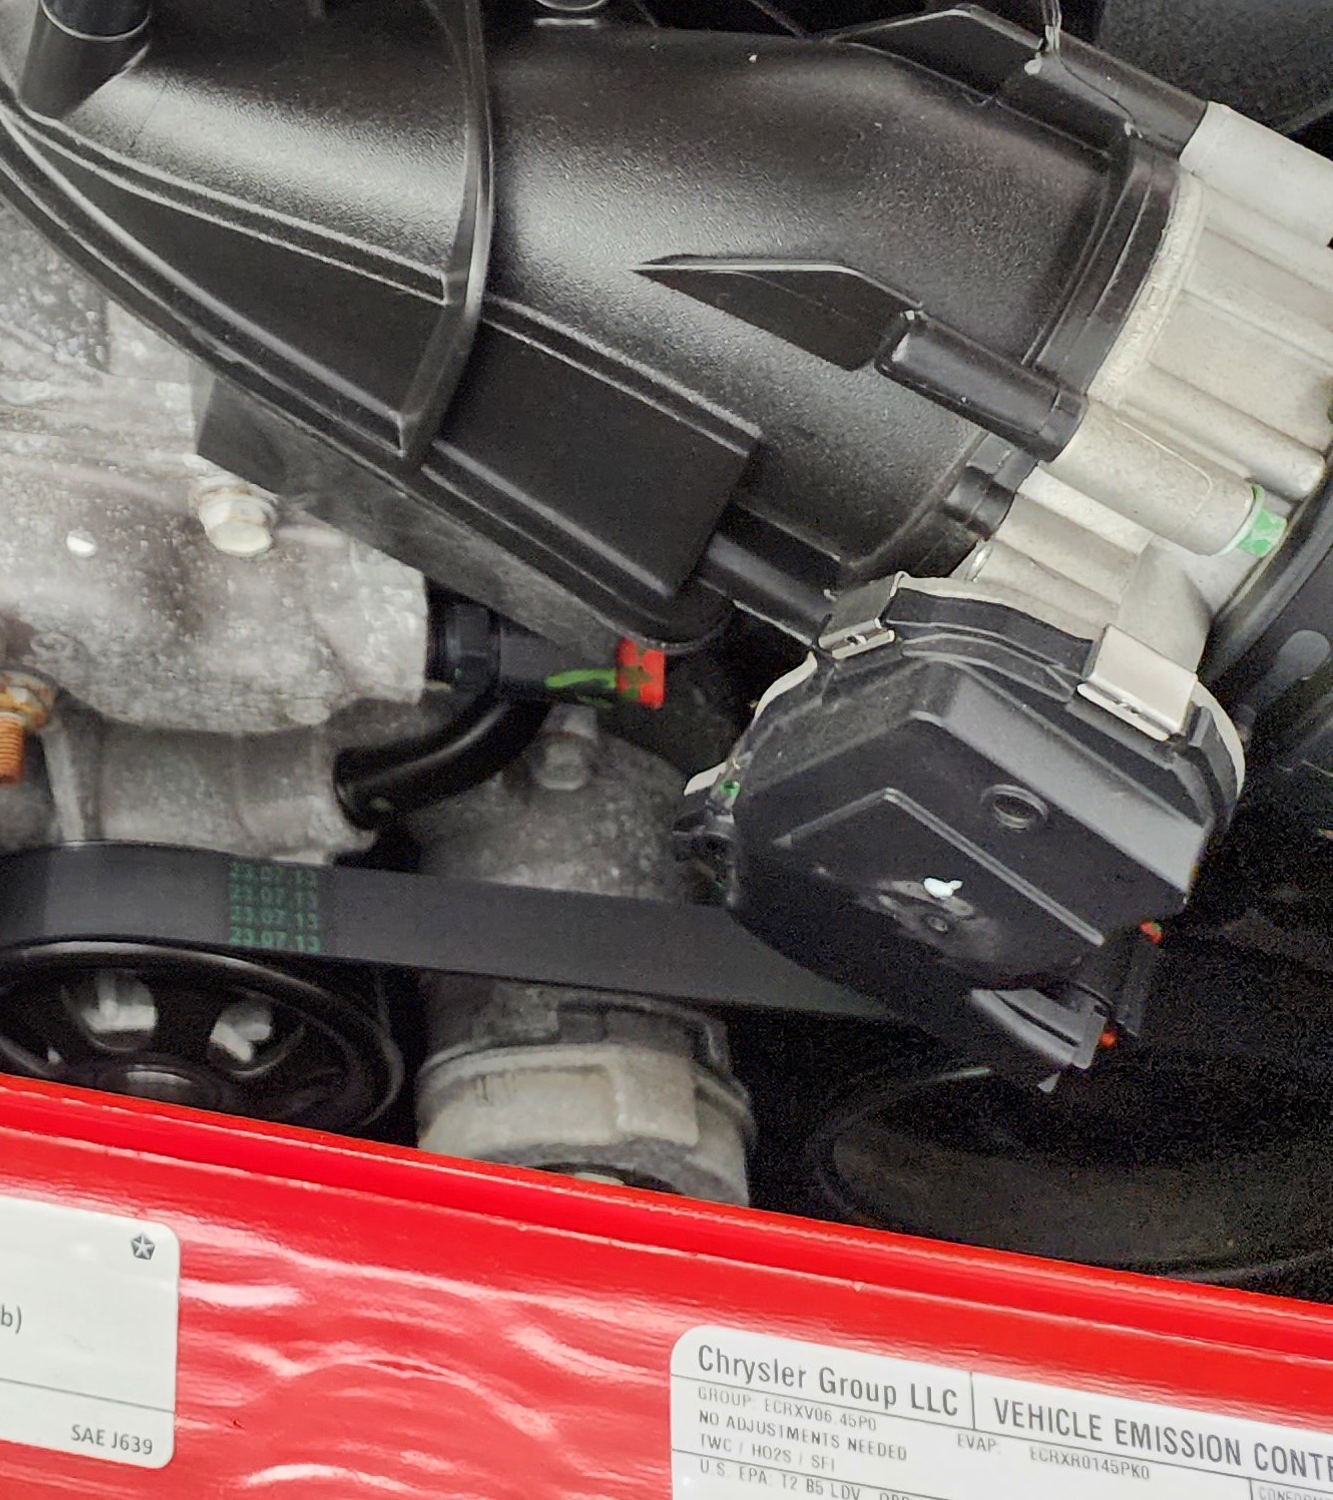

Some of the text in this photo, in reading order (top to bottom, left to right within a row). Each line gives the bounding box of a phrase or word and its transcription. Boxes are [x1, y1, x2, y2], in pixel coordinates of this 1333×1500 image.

[698, 1344, 959, 1417] Chrysler Group LLC
[70, 1424, 153, 1455] SAE J639
[698, 1410, 908, 1462] NO ADJUSTMENTS NEEDED
[700, 1434, 732, 1452] TWC
[811, 1454, 836, 1472] SFI
[993, 1397, 1104, 1442] VEHICLE
[1114, 1418, 1243, 1466] EMISSION
[782, 1474, 798, 1490] T2
[806, 1478, 824, 1495] B5
[831, 1482, 861, 1500] LDV
